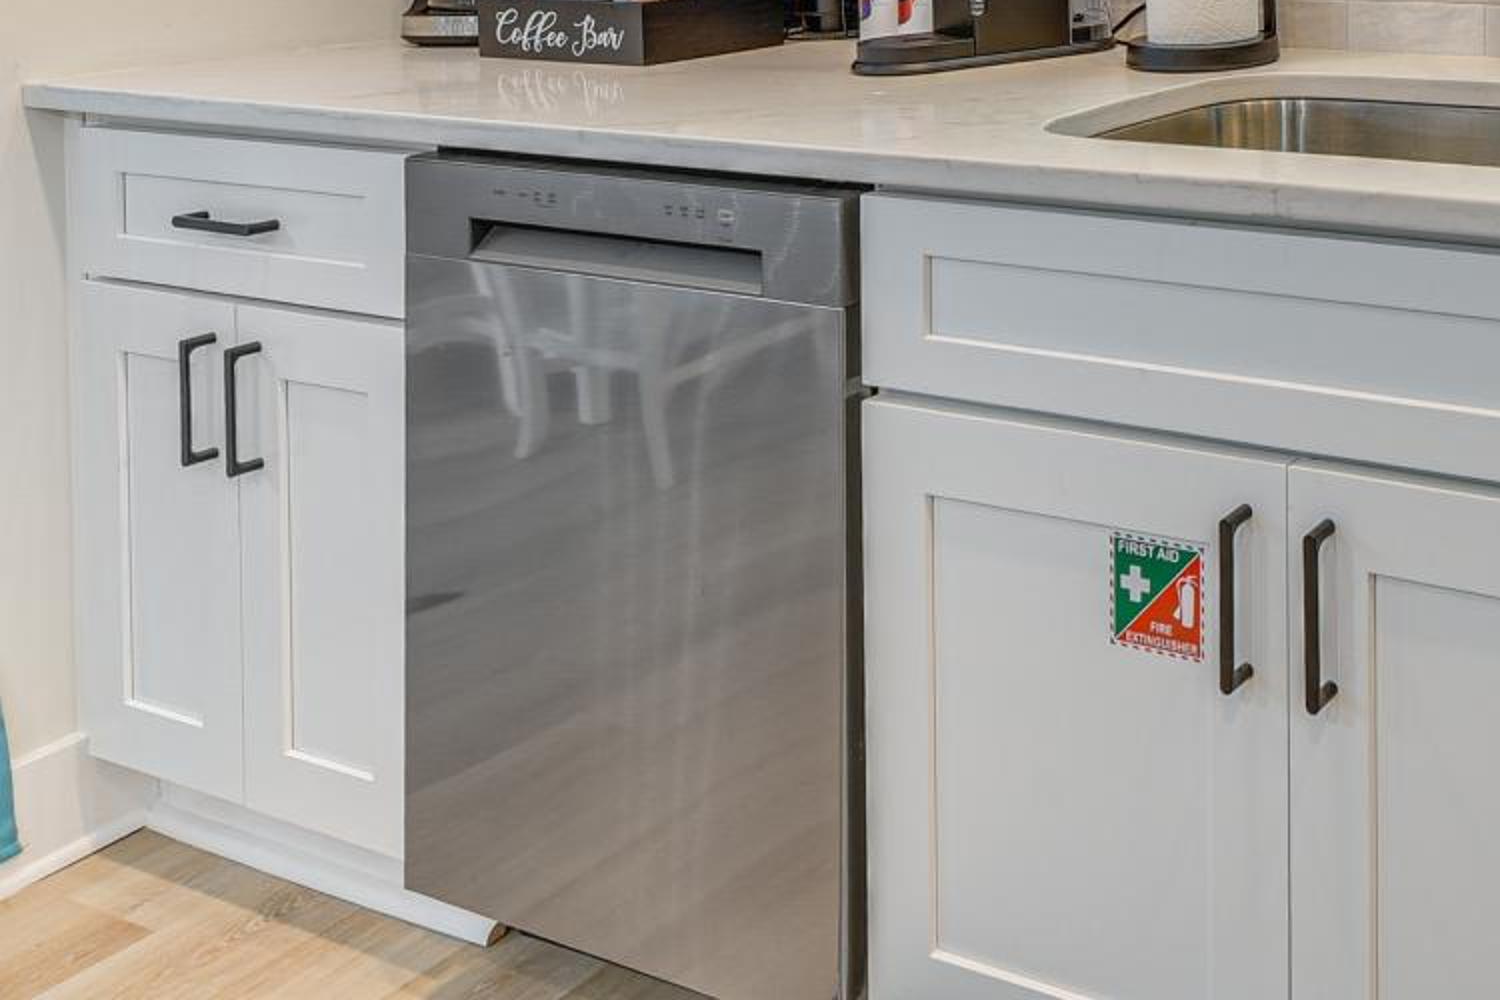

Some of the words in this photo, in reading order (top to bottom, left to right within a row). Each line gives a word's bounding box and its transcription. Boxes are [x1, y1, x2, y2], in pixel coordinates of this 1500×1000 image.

[495, 7, 568, 53] Coffee
[572, 13, 625, 57] Bar
[1117, 540, 1155, 559] FIRST
[1156, 547, 1180, 563] AID
